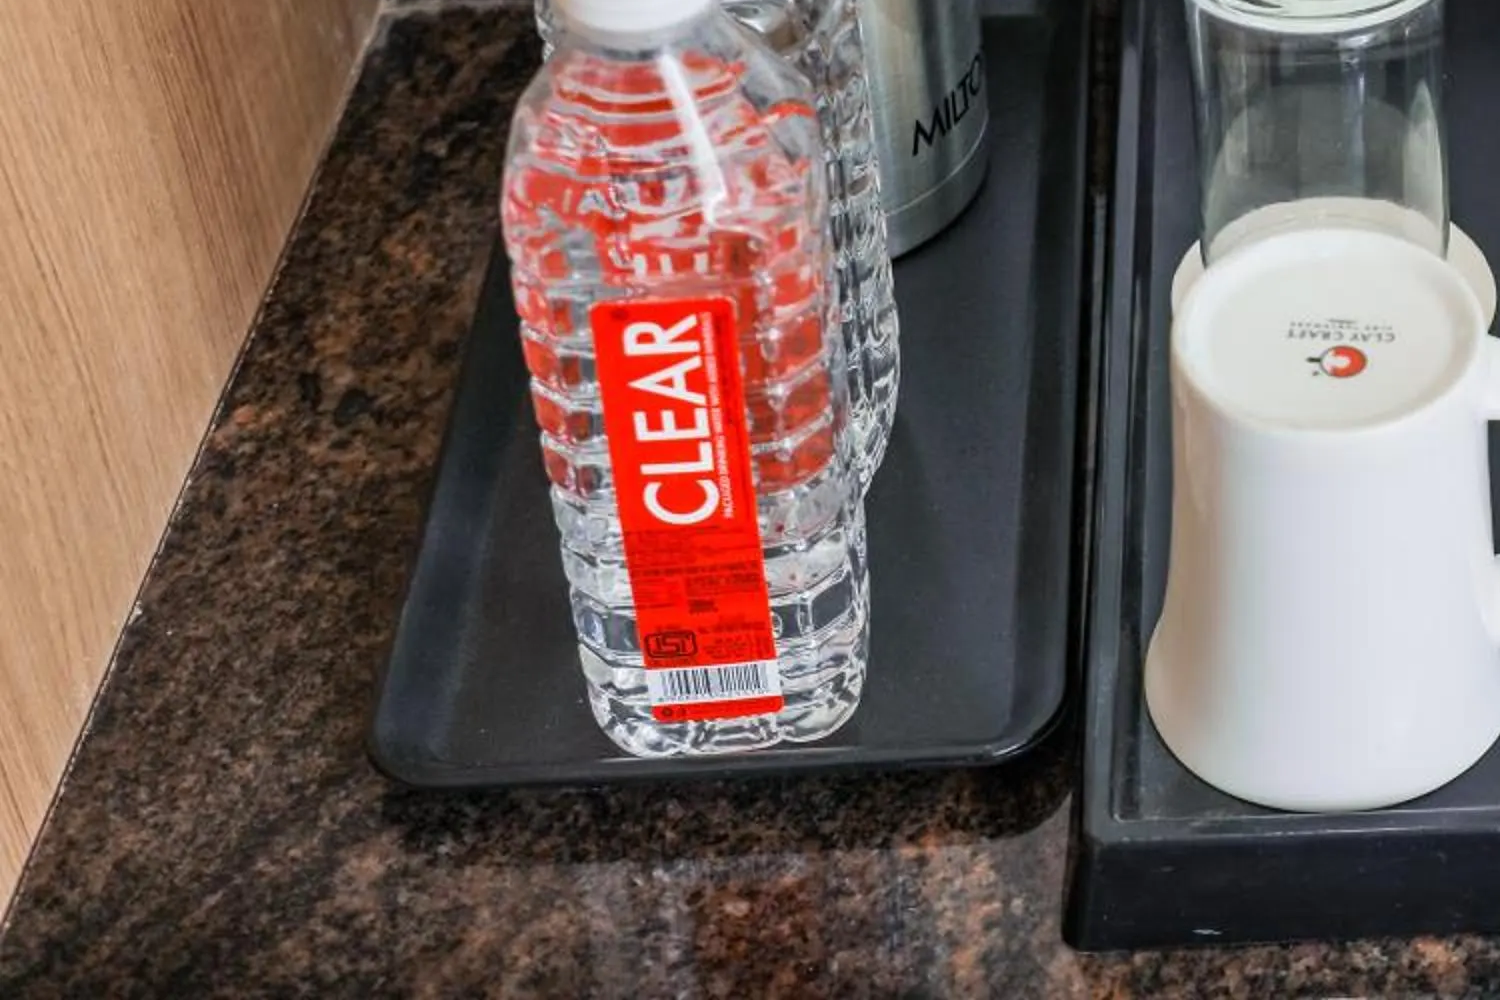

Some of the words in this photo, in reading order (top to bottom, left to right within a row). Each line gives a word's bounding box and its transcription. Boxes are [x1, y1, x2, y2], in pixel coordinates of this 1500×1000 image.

[911, 52, 981, 157] MILTO
[1350, 332, 1396, 343] CLAY
[622, 313, 720, 525] CLEAR
